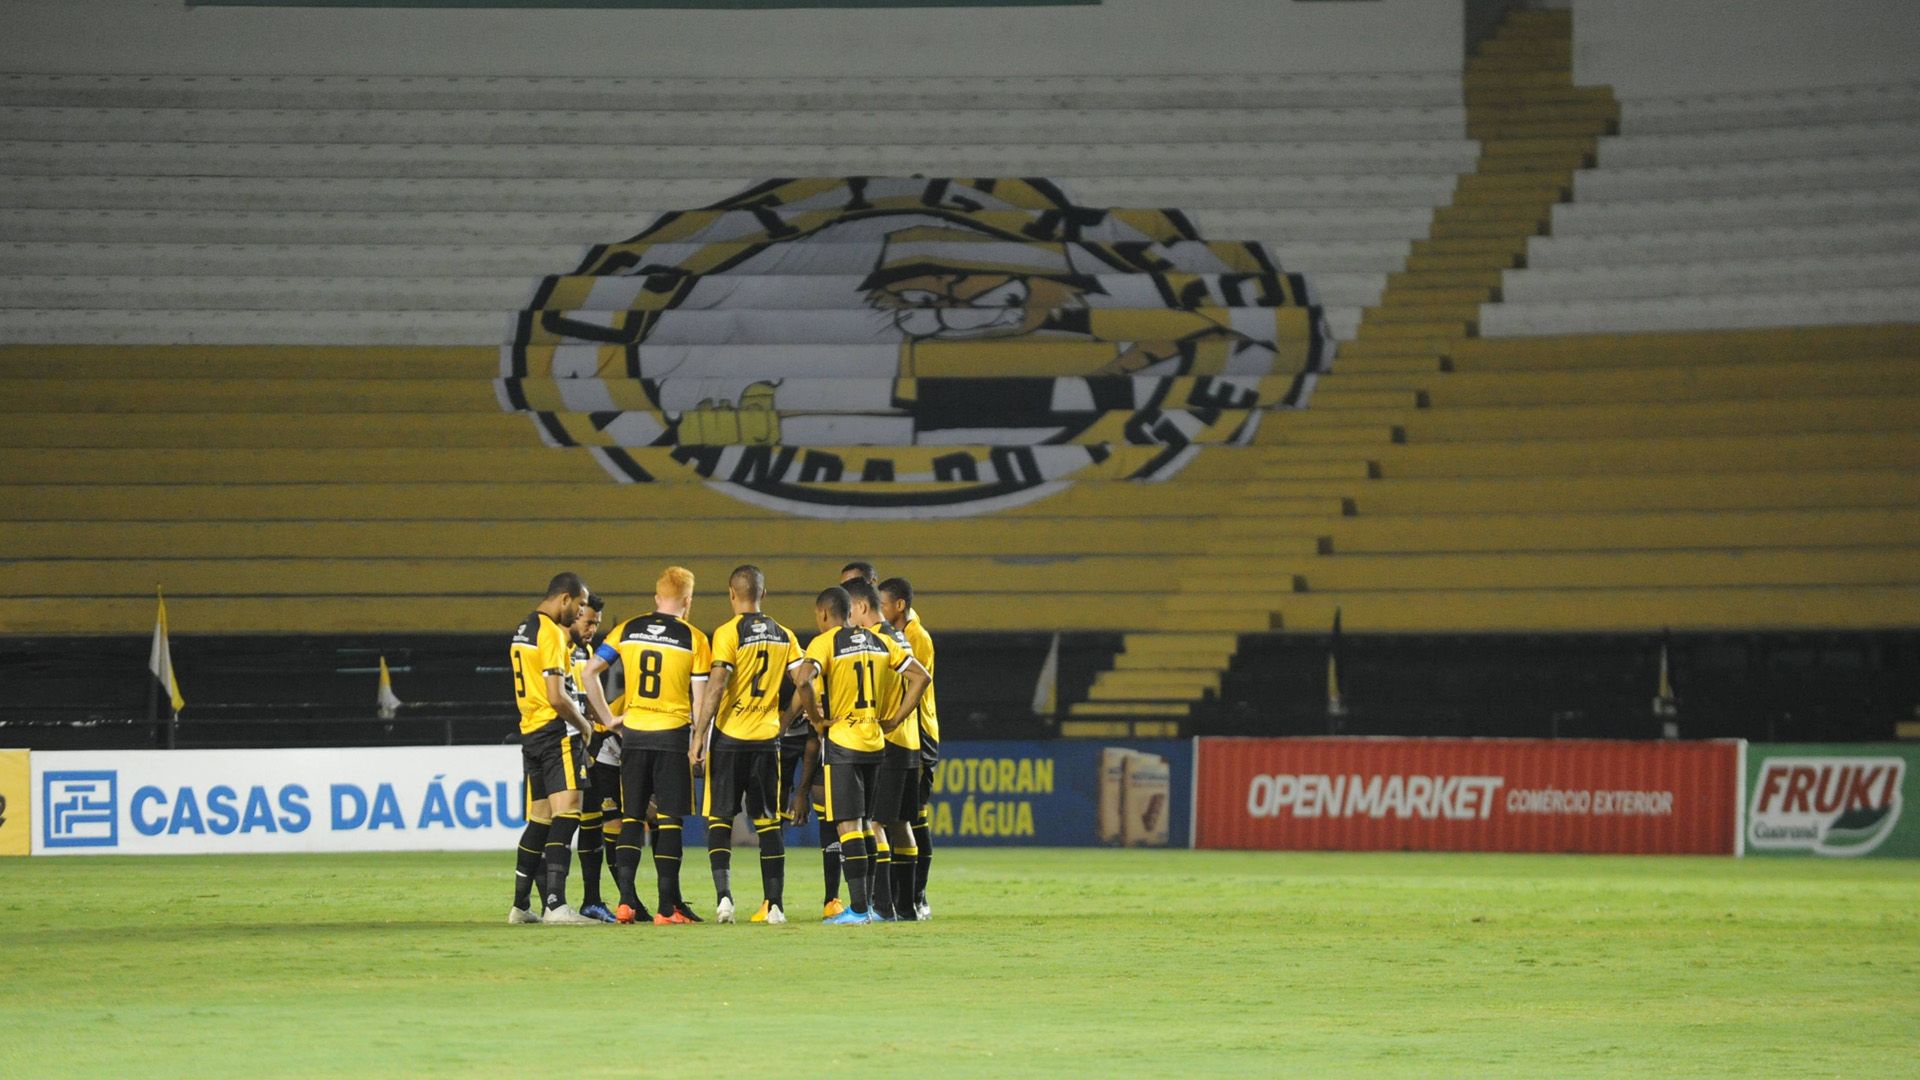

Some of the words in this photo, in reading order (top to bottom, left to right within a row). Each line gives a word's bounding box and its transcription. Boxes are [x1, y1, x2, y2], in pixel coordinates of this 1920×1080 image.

[513, 650, 526, 698] 3
[638, 649, 663, 699] 8
[750, 649, 769, 698] 2
[852, 659, 877, 710] 11
[932, 758, 1054, 794] VOTORAN
[1757, 765, 1899, 814] FRUKI
[130, 784, 312, 836] CASAS
[330, 782, 406, 831] DA
[959, 795, 1035, 836] ÁGUA
[1506, 786, 1591, 814] COMÉRCIO
[1593, 789, 1674, 816] EXTERIOR
